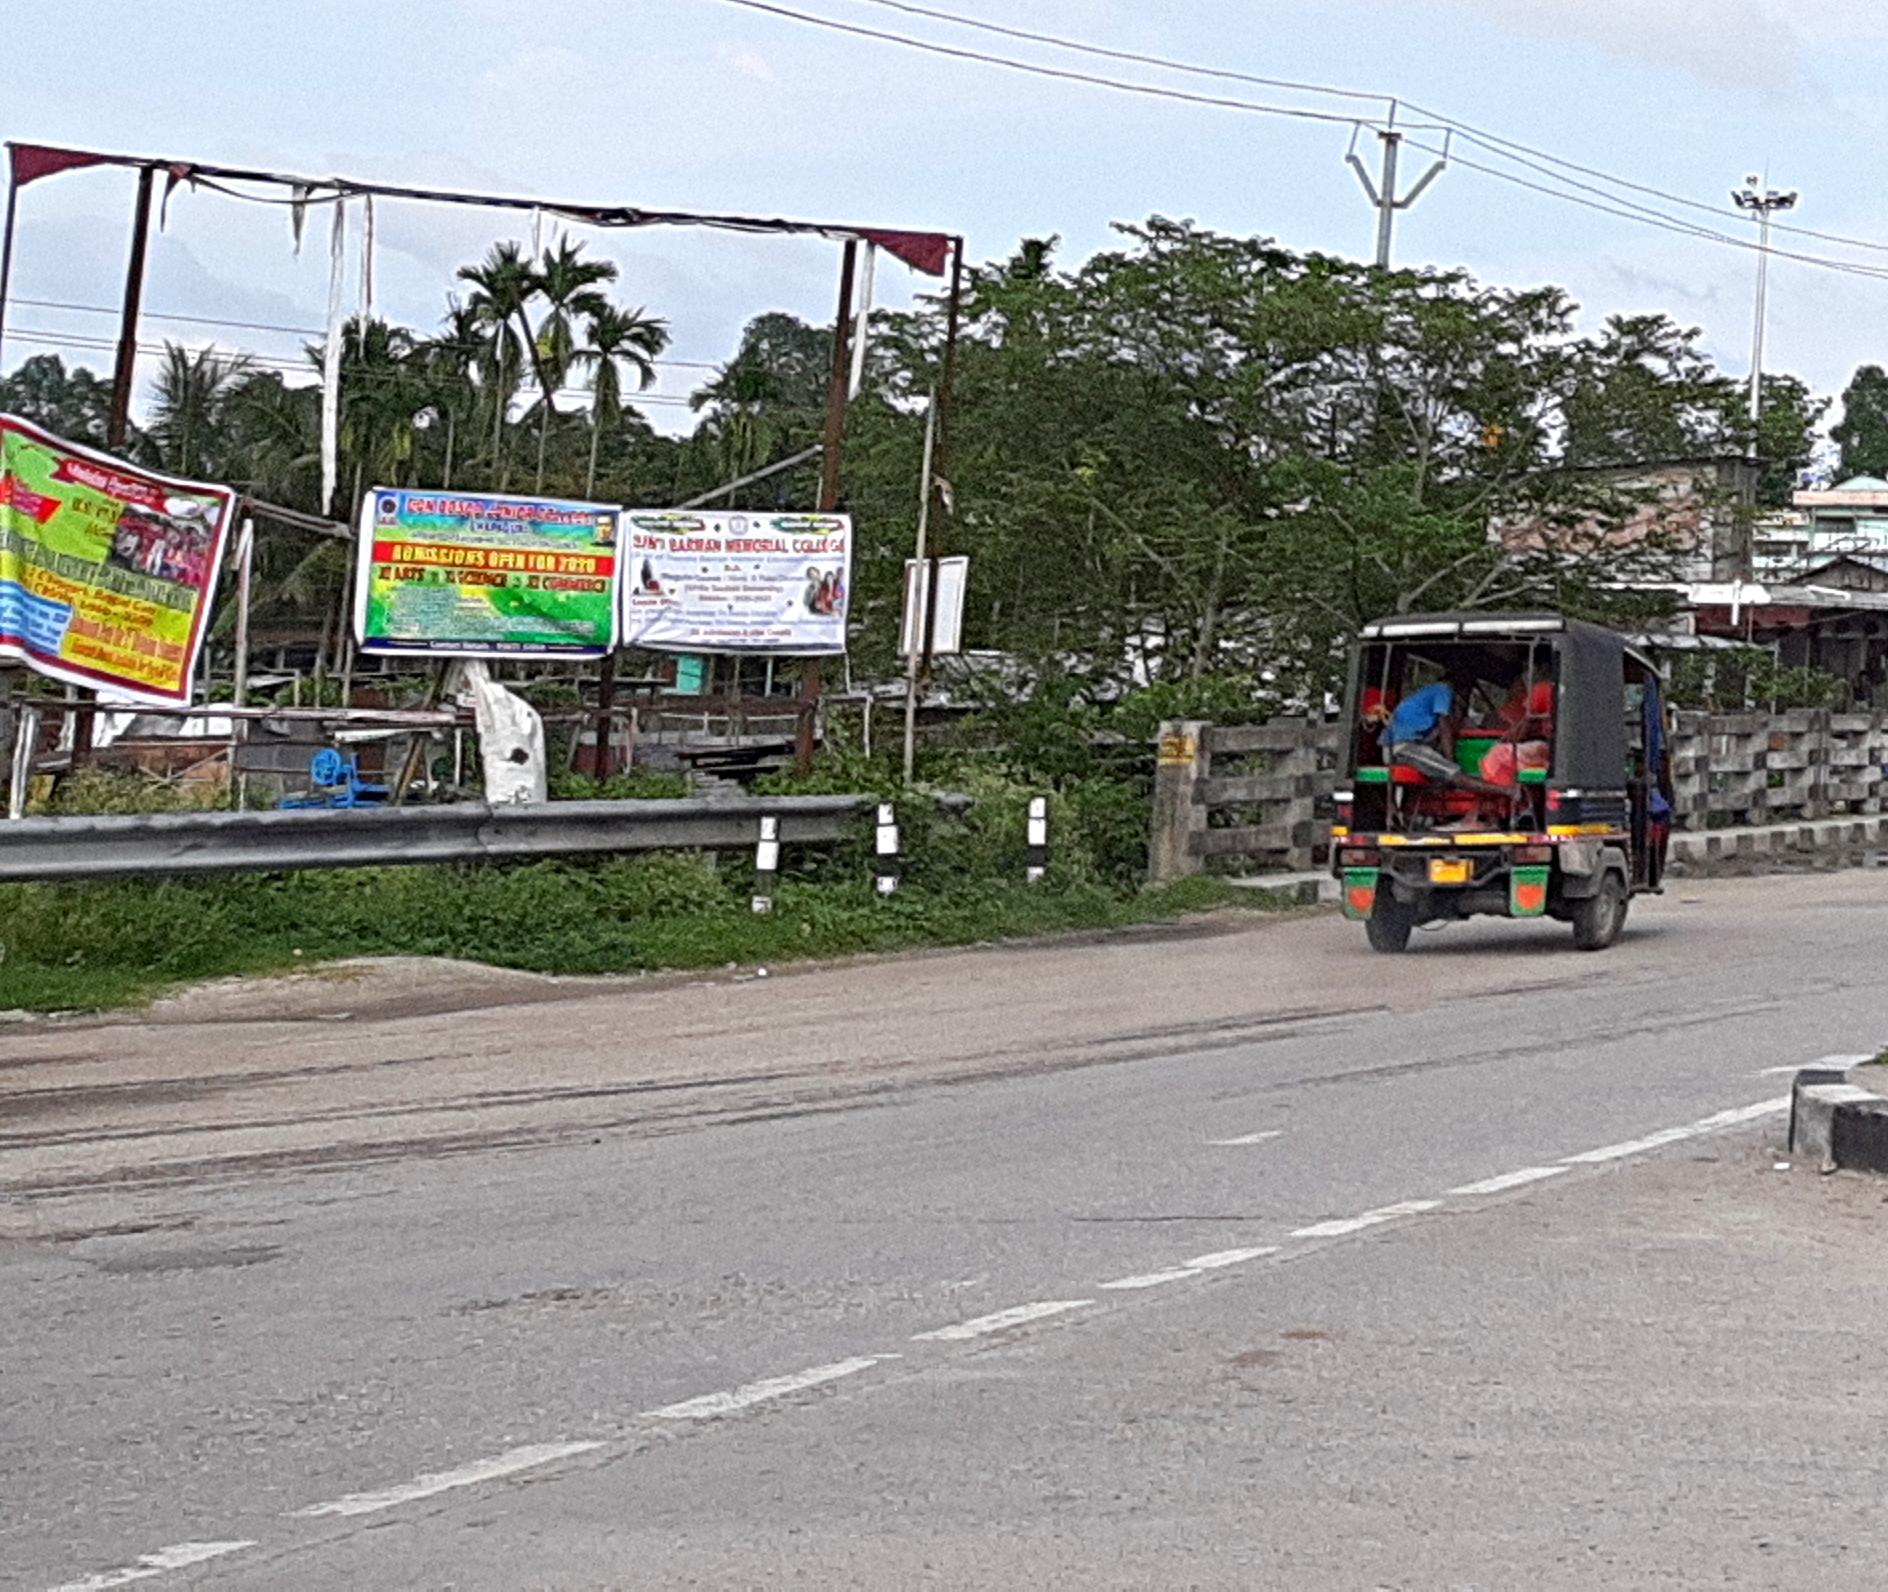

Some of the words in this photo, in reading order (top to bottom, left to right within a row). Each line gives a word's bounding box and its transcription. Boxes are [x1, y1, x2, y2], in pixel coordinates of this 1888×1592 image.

[392, 544, 486, 567] ADMISSIONS
[489, 551, 525, 569] OPEN
[527, 554, 555, 571] FOR
[558, 555, 596, 573] 2020
